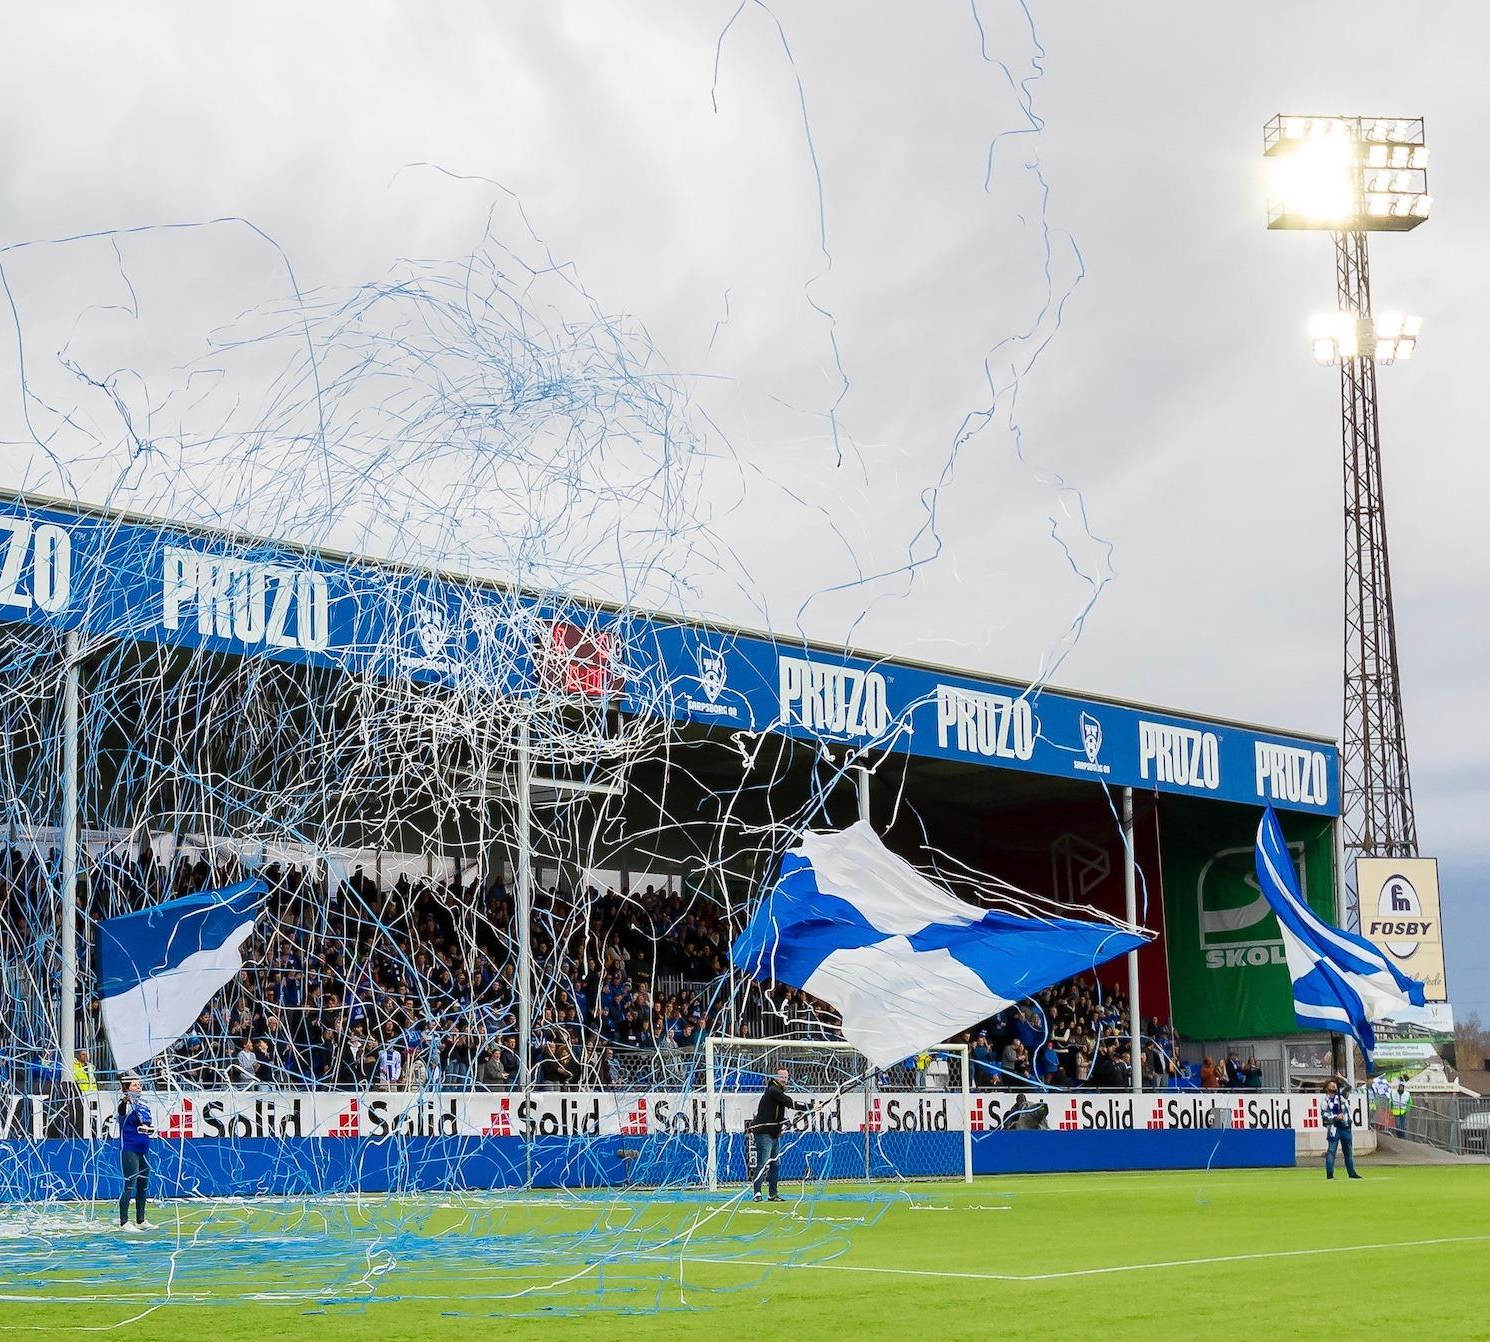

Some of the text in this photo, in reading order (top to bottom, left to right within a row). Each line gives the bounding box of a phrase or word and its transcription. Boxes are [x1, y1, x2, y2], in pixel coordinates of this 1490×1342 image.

[1370, 921, 1432, 936] FOSBY
[202, 1098, 301, 1138] Solid
[367, 1098, 458, 1138] Solid
[517, 1098, 600, 1136] Solid
[887, 1098, 948, 1132] Solid
[1081, 1098, 1134, 1130] Solid
[1248, 1098, 1292, 1129] Solid
